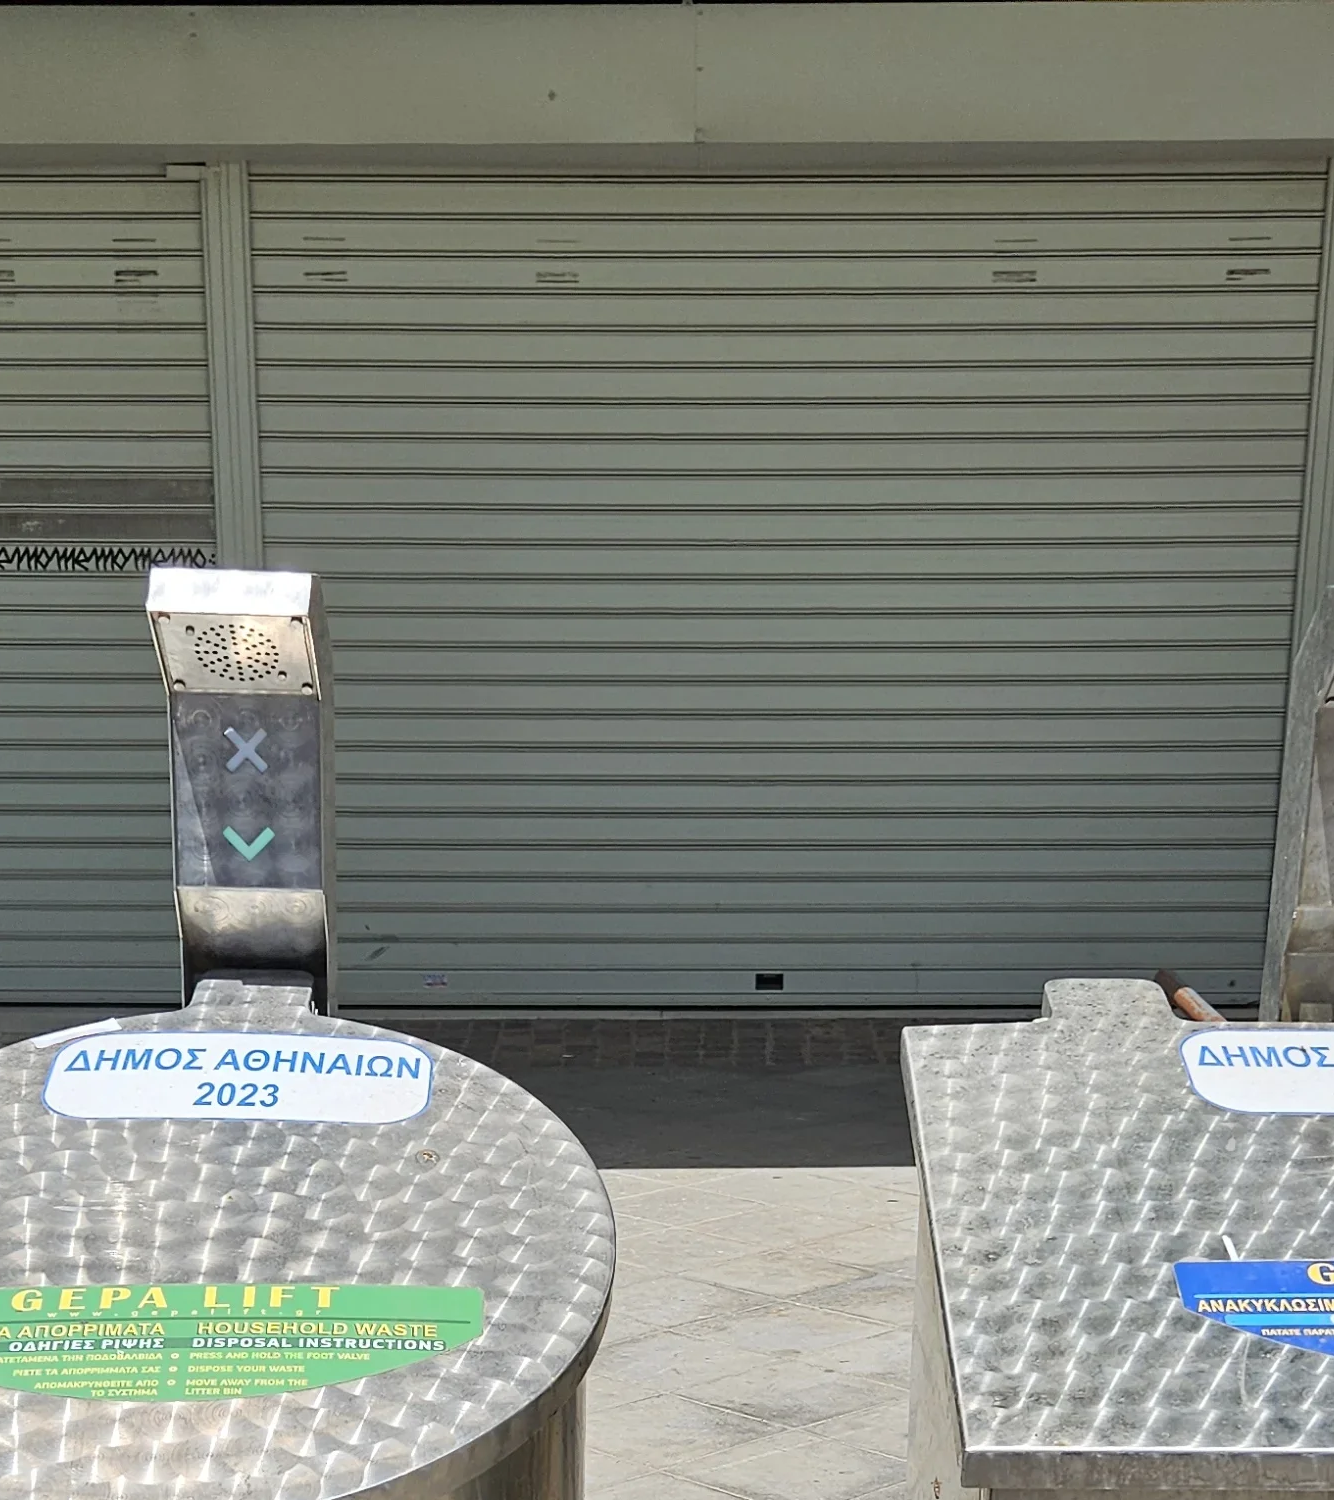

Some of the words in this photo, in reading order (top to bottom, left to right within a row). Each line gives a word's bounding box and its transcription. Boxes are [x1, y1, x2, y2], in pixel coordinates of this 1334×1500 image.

[64, 1048, 207, 1073] ΔΗΜΟΣ
[214, 1049, 421, 1080] ΑΘΗΝΑΙΩΝ
[193, 1082, 280, 1108] 2023
[11, 1287, 168, 1312] GEPA
[204, 1286, 340, 1309] LIFT
[16, 1322, 166, 1339] ΑΠΟΡΡΙΜΑΤΑ
[197, 1321, 348, 1336] HOUSEHOLD
[355, 1322, 438, 1338] WASTE
[8, 1340, 95, 1352] ΟΔΗΓΙΕΣ
[101, 1337, 165, 1350] ΡΙΨΗΣ
[192, 1337, 292, 1349] DISPOSAL
[298, 1338, 446, 1351] INSTRUCTIONS
[284, 1352, 304, 1360] THE
[307, 1352, 334, 1360] FOOT
[337, 1352, 370, 1361] VALVE
[187, 1365, 233, 1373] DISPOSE
[236, 1365, 266, 1373] YOUR
[269, 1365, 305, 1373] WASTE
[185, 1387, 221, 1395] LITTER
[223, 1387, 242, 1395] BIN
